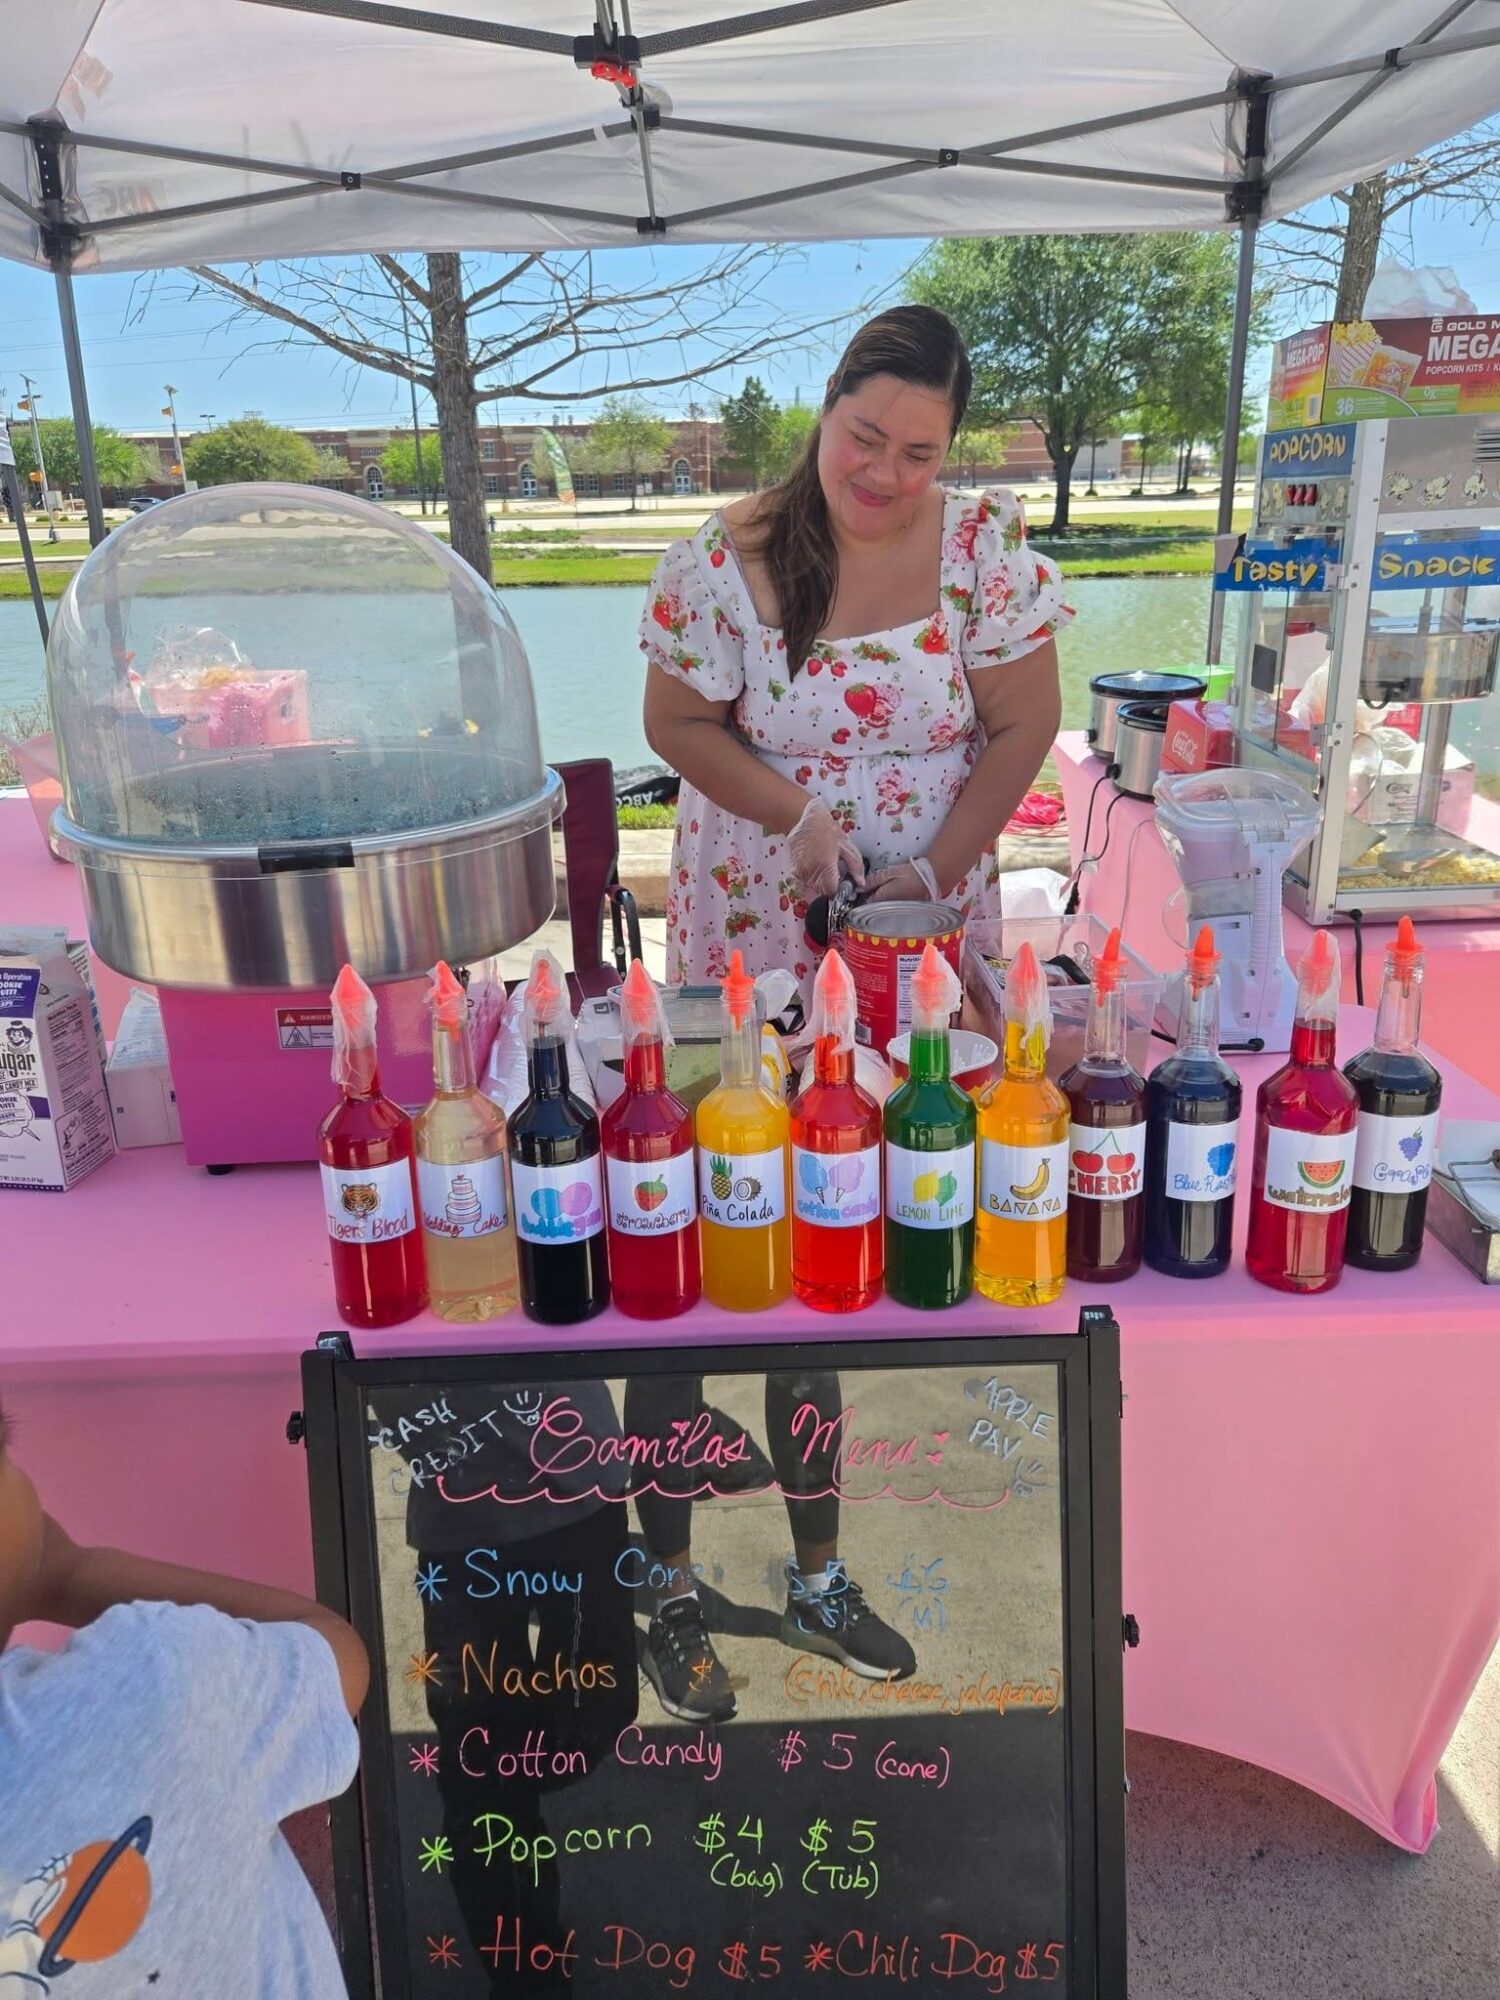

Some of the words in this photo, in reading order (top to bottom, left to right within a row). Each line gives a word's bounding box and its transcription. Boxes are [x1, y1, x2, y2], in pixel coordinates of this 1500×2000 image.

[1446, 321, 1487, 332] GOLD
[1425, 364, 1465, 375] POPCORN
[1466, 363, 1484, 373] KITS
[1268, 433, 1347, 464] POPCORN
[1232, 556, 1318, 588] Tasty
[1378, 553, 1497, 582] Snack
[1068, 1169, 1142, 1196] CHERRY
[1173, 1174, 1202, 1192] Blue
[726, 1197, 775, 1222] Colada
[896, 1202, 931, 1222] LEMON
[938, 1202, 965, 1222] LIME
[988, 1192, 1062, 1216] BANANA
[327, 1214, 367, 1240] Tigers
[371, 1207, 409, 1241] Blood
[472, 1213, 503, 1234] Cake
[369, 1397, 459, 1452] CASH
[983, 1376, 1056, 1440] APPLE
[388, 1409, 503, 1494] CREDIT
[967, 1418, 1022, 1461] PAY
[464, 1548, 585, 1598] Snow
[614, 1547, 705, 1589] Con
[461, 1640, 618, 1698] Nachos
[458, 1727, 588, 1779] Cotton
[614, 1724, 723, 1782] Candy
[875, 1740, 951, 1789] (cone)
[472, 1812, 652, 1888] Popcorn
[709, 1852, 783, 1899] (bag)
[802, 1859, 880, 1900] (Tub)
[479, 1914, 580, 1979] Hot
[594, 1924, 696, 1989] Dog
[835, 1929, 920, 1983] Chili
[930, 1931, 1006, 1994] Dog
